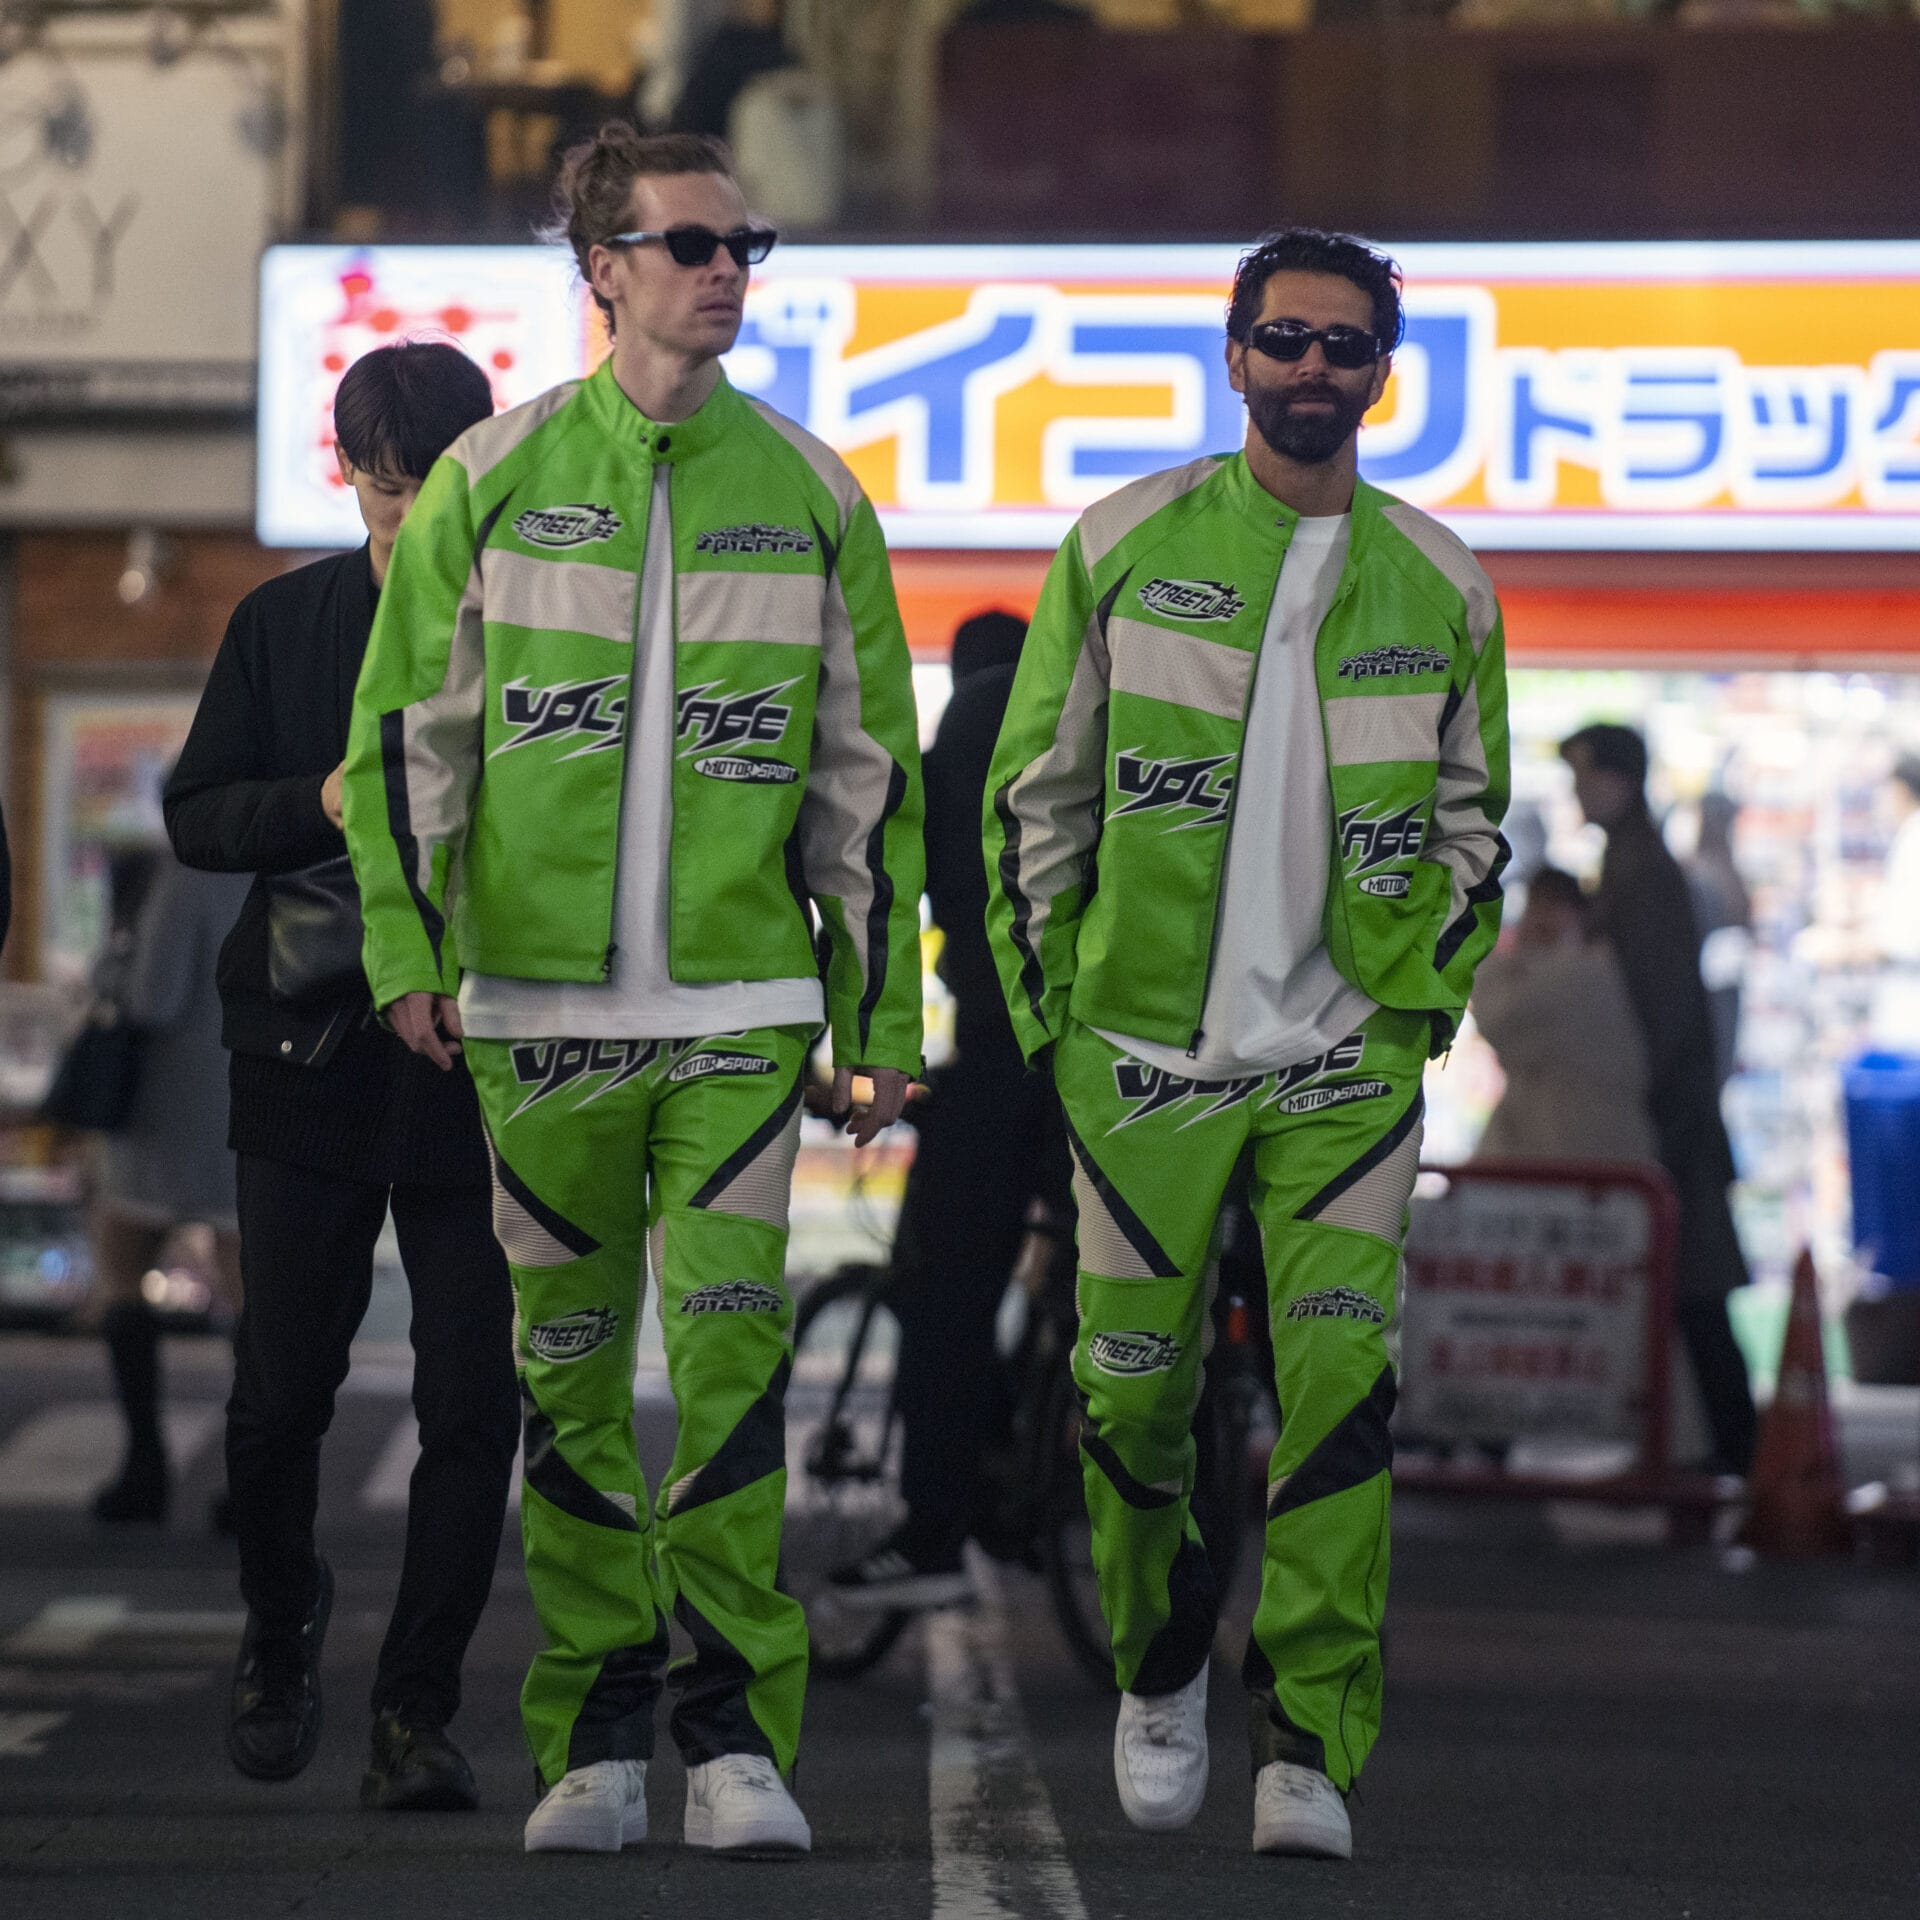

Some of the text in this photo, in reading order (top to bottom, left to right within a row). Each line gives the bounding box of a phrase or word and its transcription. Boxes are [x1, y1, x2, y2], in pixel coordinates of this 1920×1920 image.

[512, 508, 622, 540] STREETLIFE
[1138, 577, 1247, 620] STREETLIFE
[529, 1312, 619, 1347] STREETLIFE
[1089, 1331, 1183, 1367] STREETLIFE
